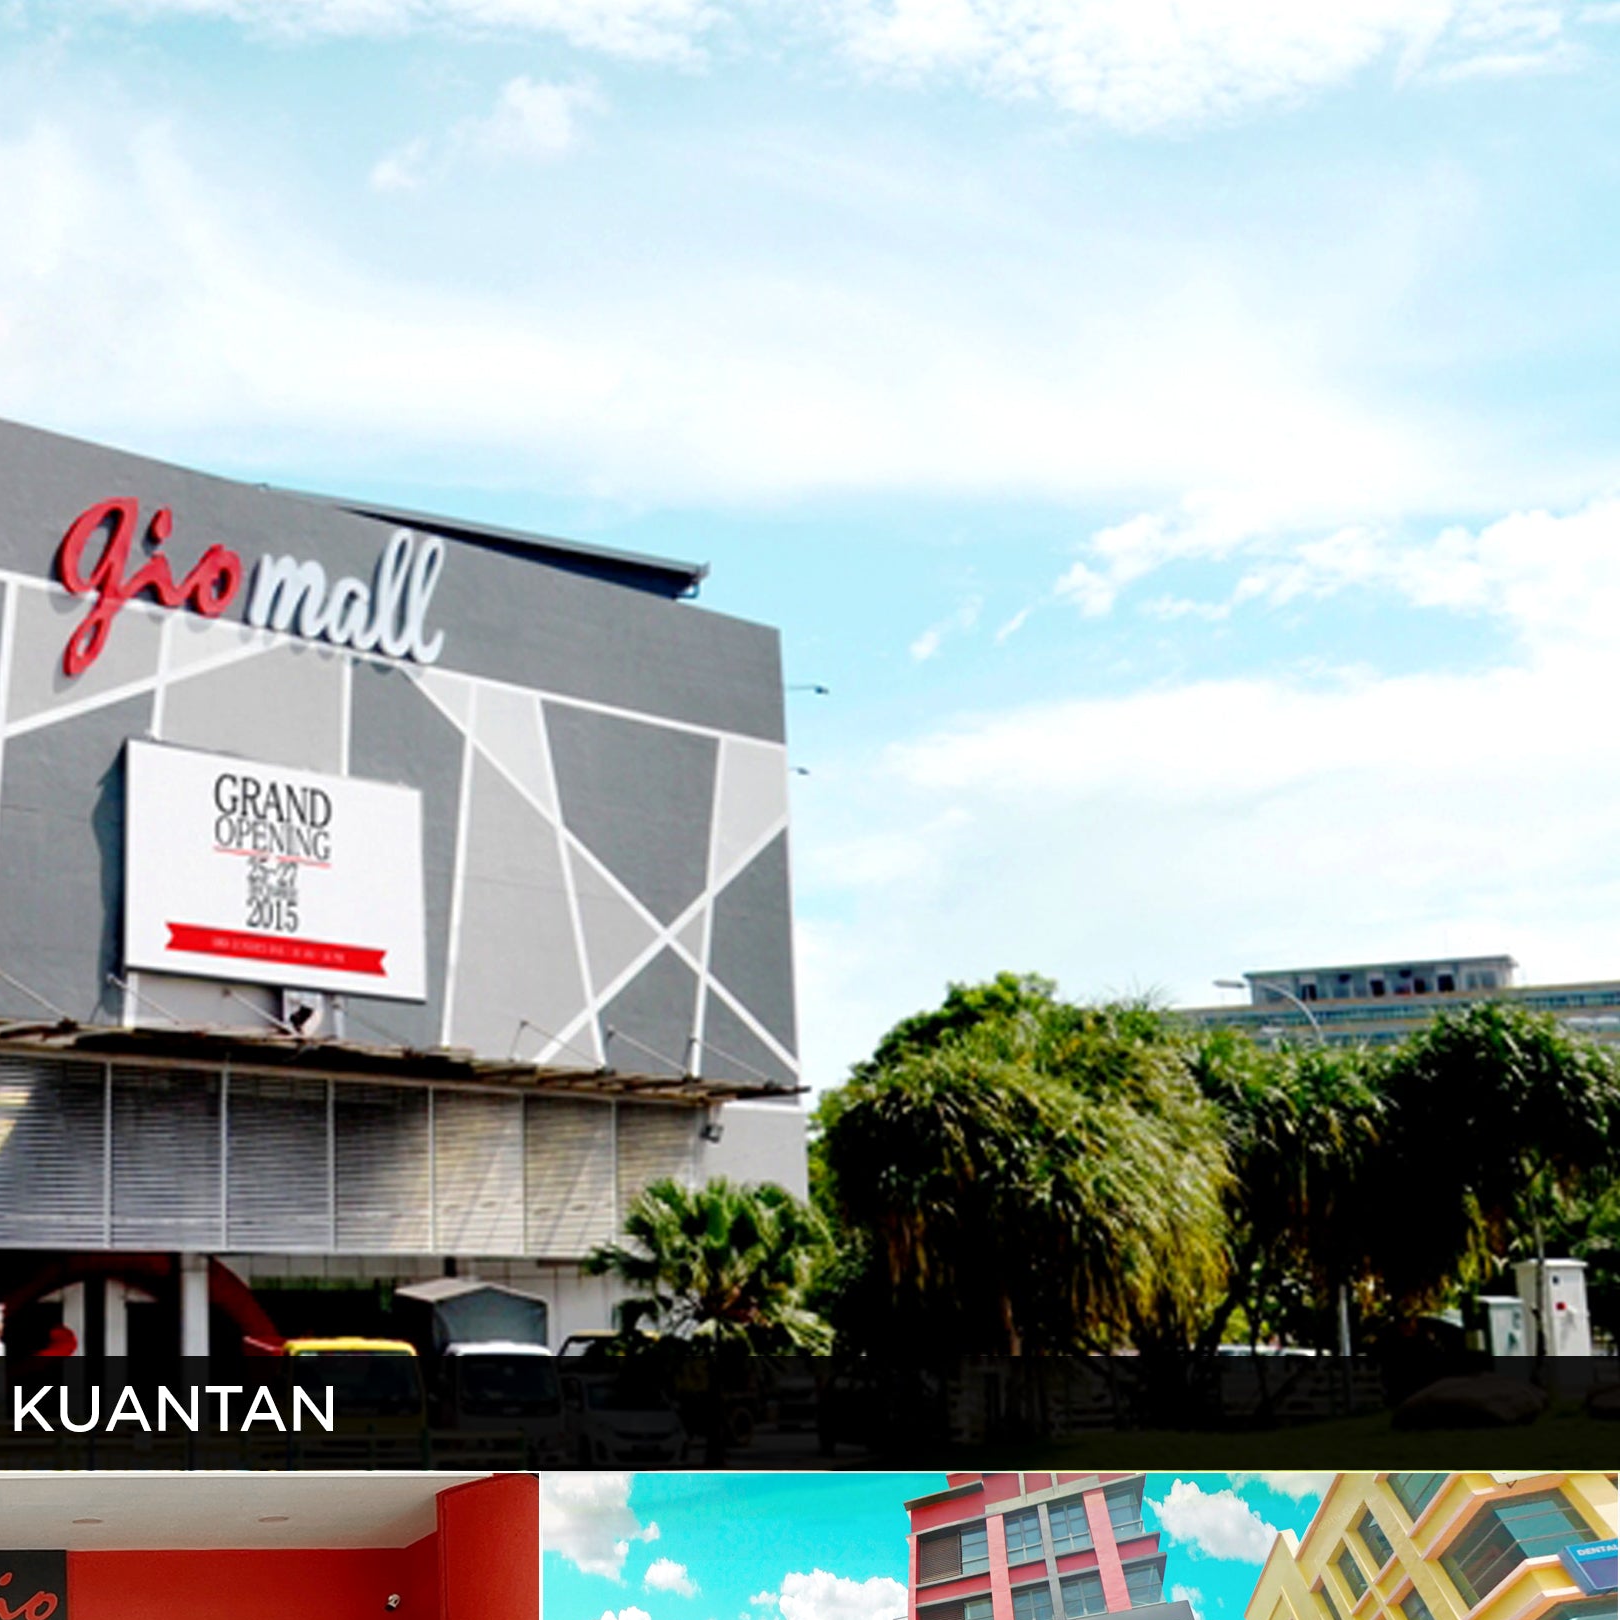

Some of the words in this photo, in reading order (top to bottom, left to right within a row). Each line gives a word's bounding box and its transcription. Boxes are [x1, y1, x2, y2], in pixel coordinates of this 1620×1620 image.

[57, 496, 242, 680] gio
[249, 529, 445, 664] mall
[214, 773, 332, 827] GRAND
[213, 817, 331, 861] OPENING
[246, 896, 299, 933] 2015
